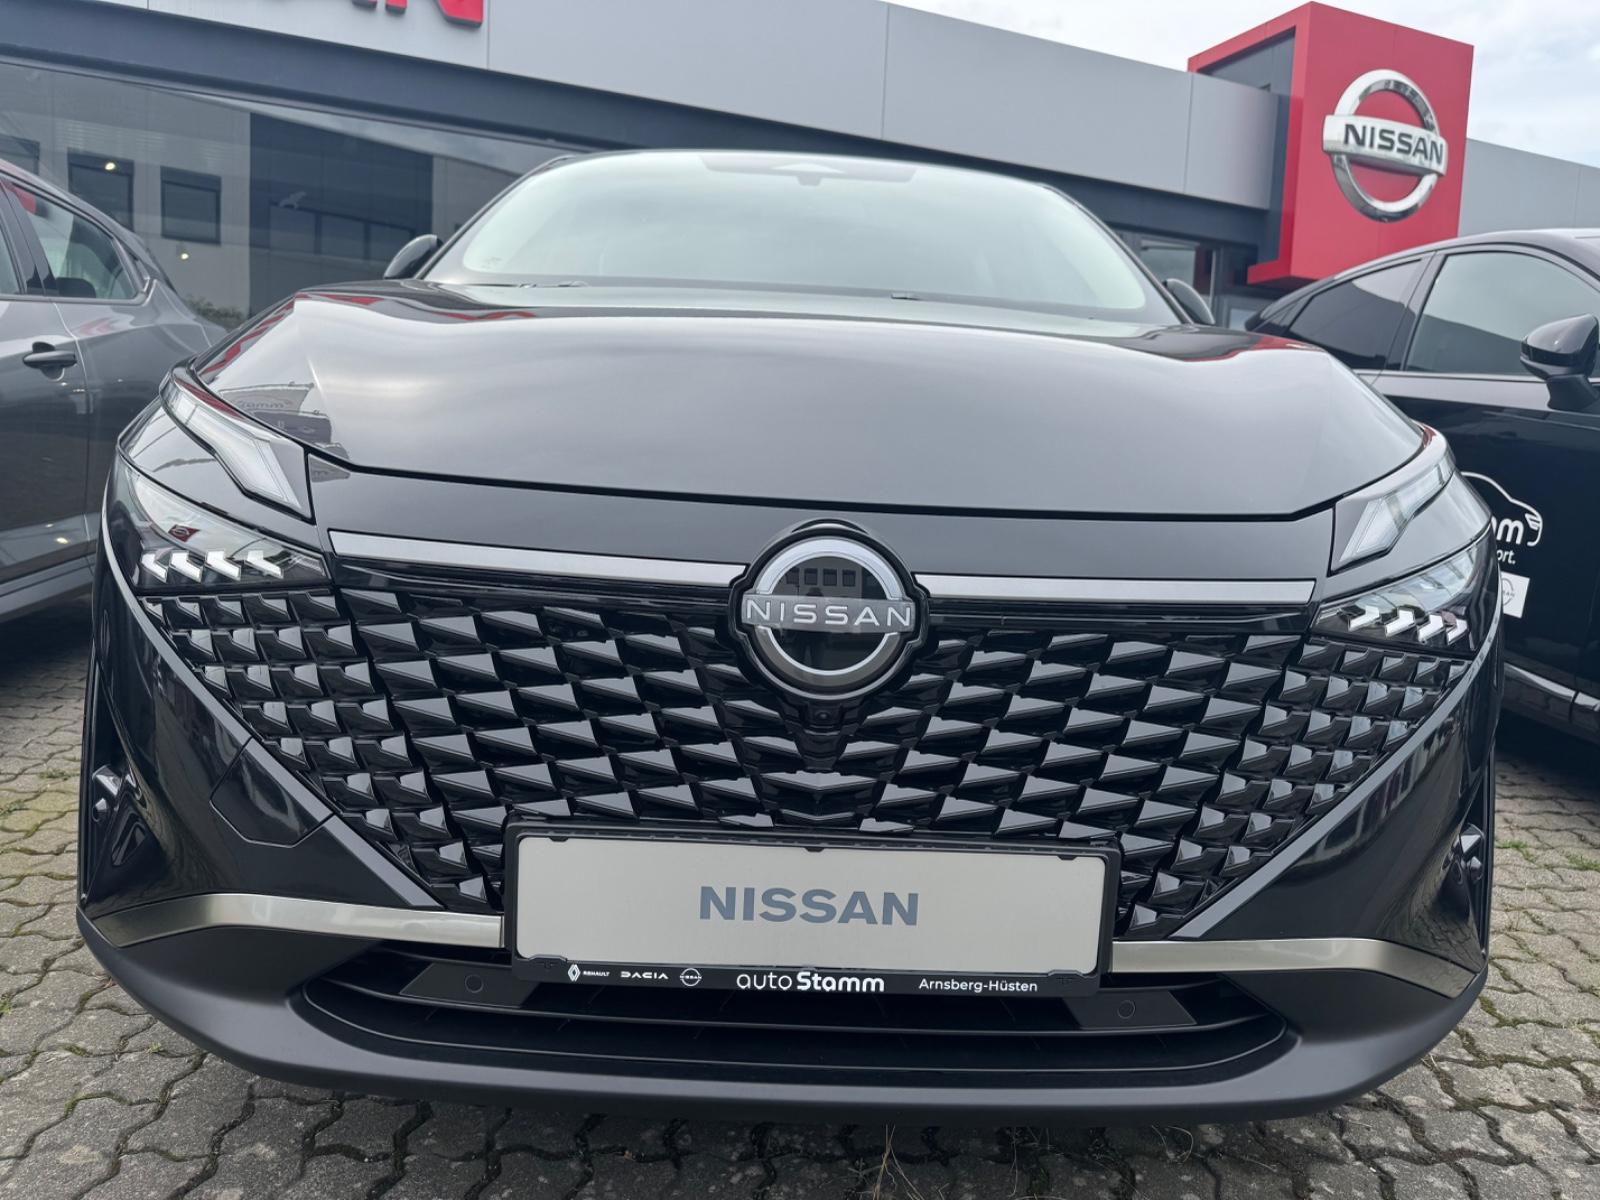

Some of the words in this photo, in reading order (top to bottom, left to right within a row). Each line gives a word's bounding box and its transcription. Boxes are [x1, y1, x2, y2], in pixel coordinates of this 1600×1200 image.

[1343, 122, 1443, 166] NISSAN
[746, 599, 911, 627] NISSAN
[700, 886, 918, 926] NISSAN
[620, 971, 669, 980] DACIA
[736, 972, 792, 990] auto
[796, 971, 885, 992] Stamm
[918, 978, 1038, 993] Arnsberg-Hüsten
